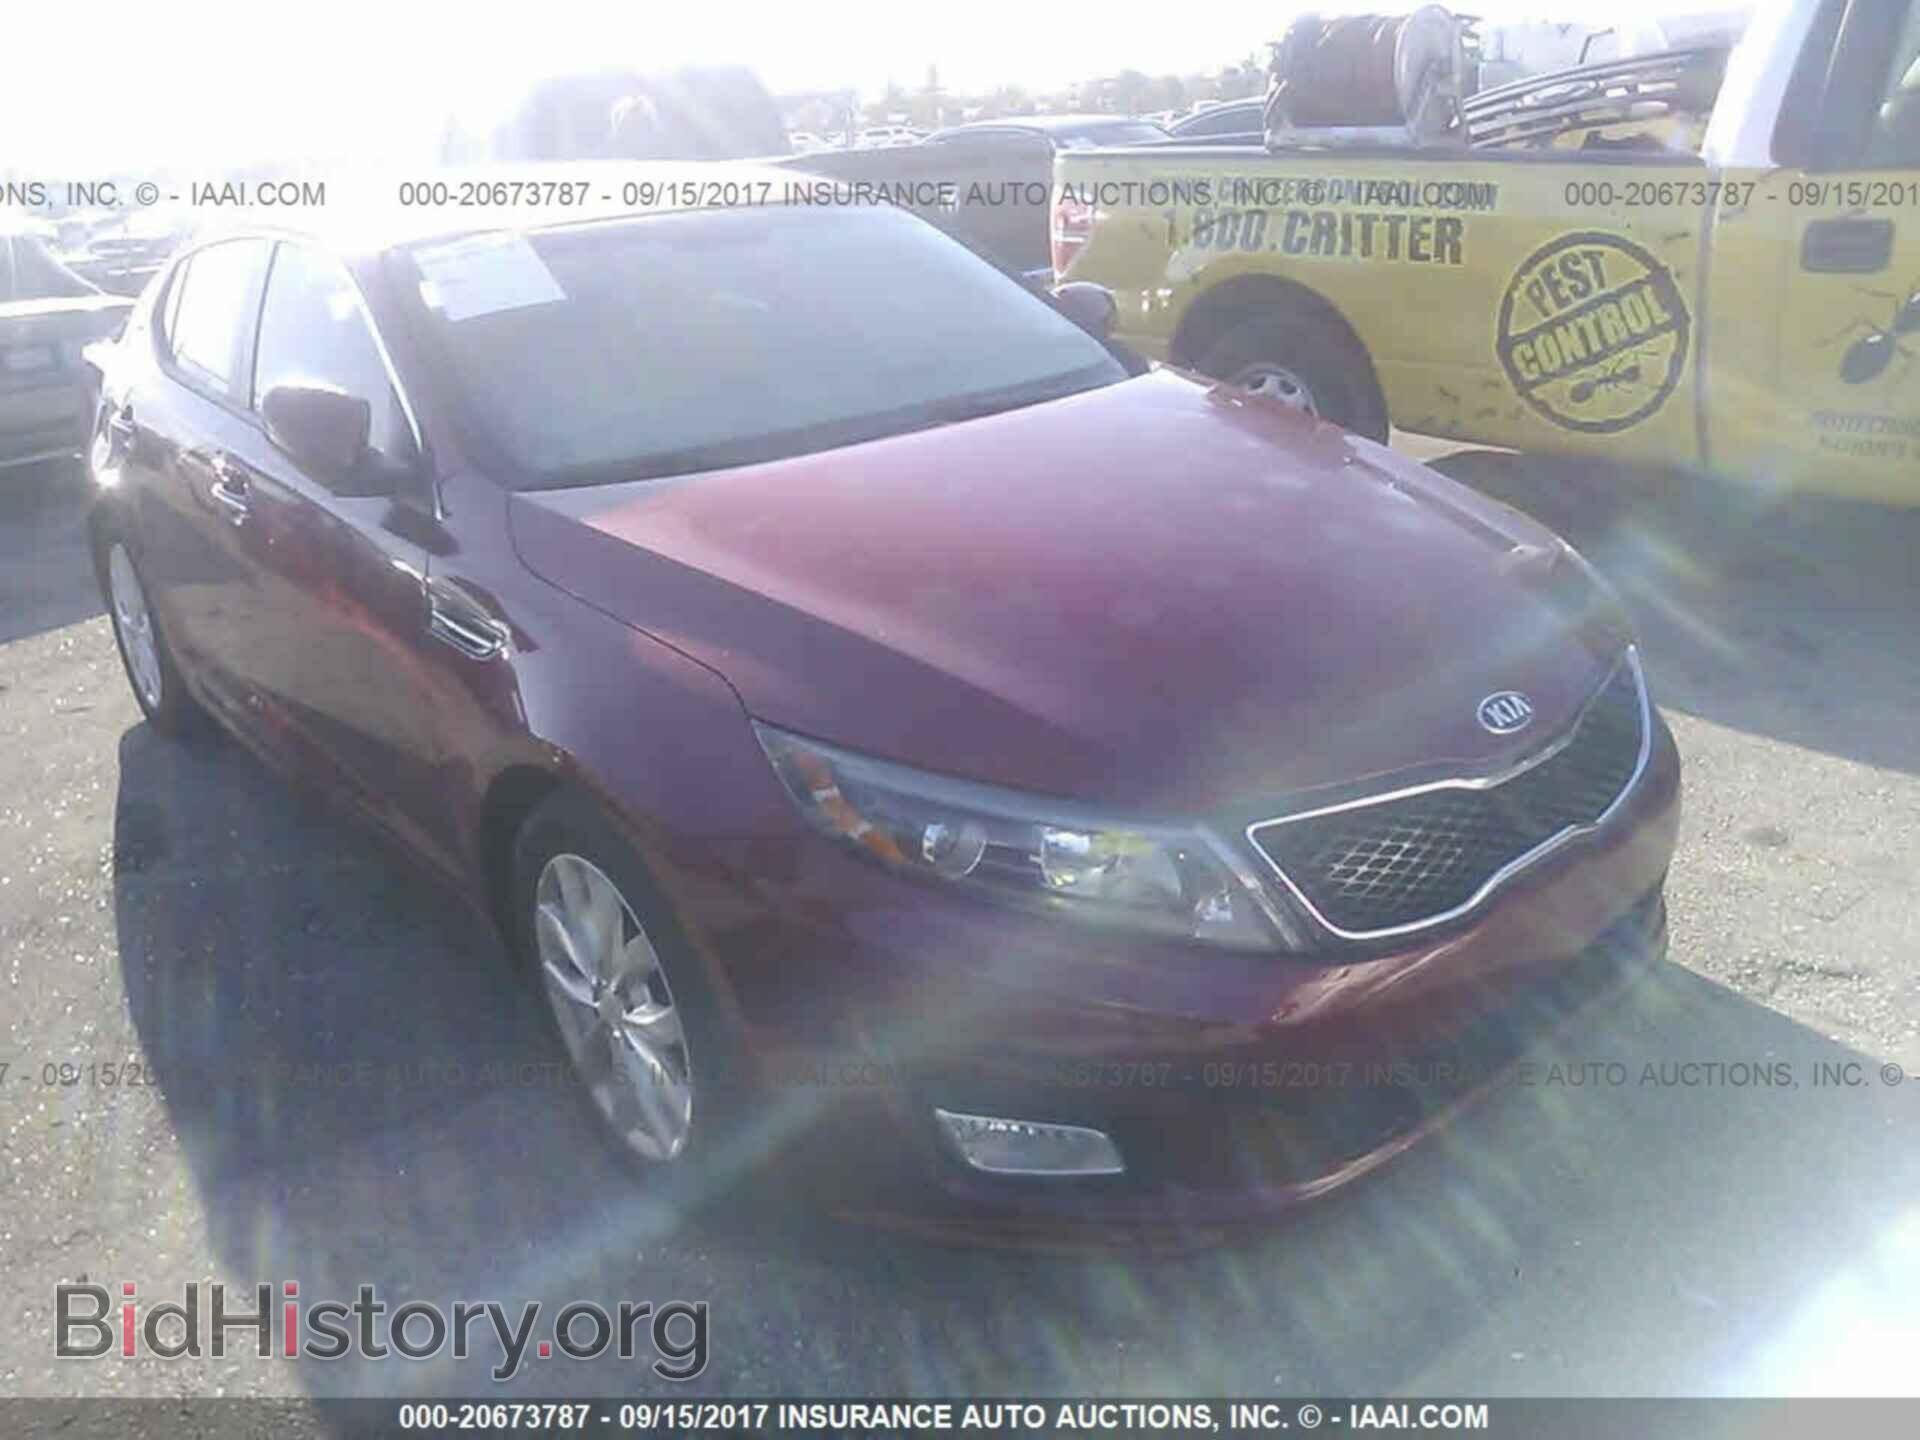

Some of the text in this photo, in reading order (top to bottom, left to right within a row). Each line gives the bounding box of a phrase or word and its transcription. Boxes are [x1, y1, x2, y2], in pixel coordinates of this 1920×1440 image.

[1526, 251, 1606, 317] PEST
[1512, 285, 1672, 382] CONTROL
[1486, 696, 1531, 727] KIA
